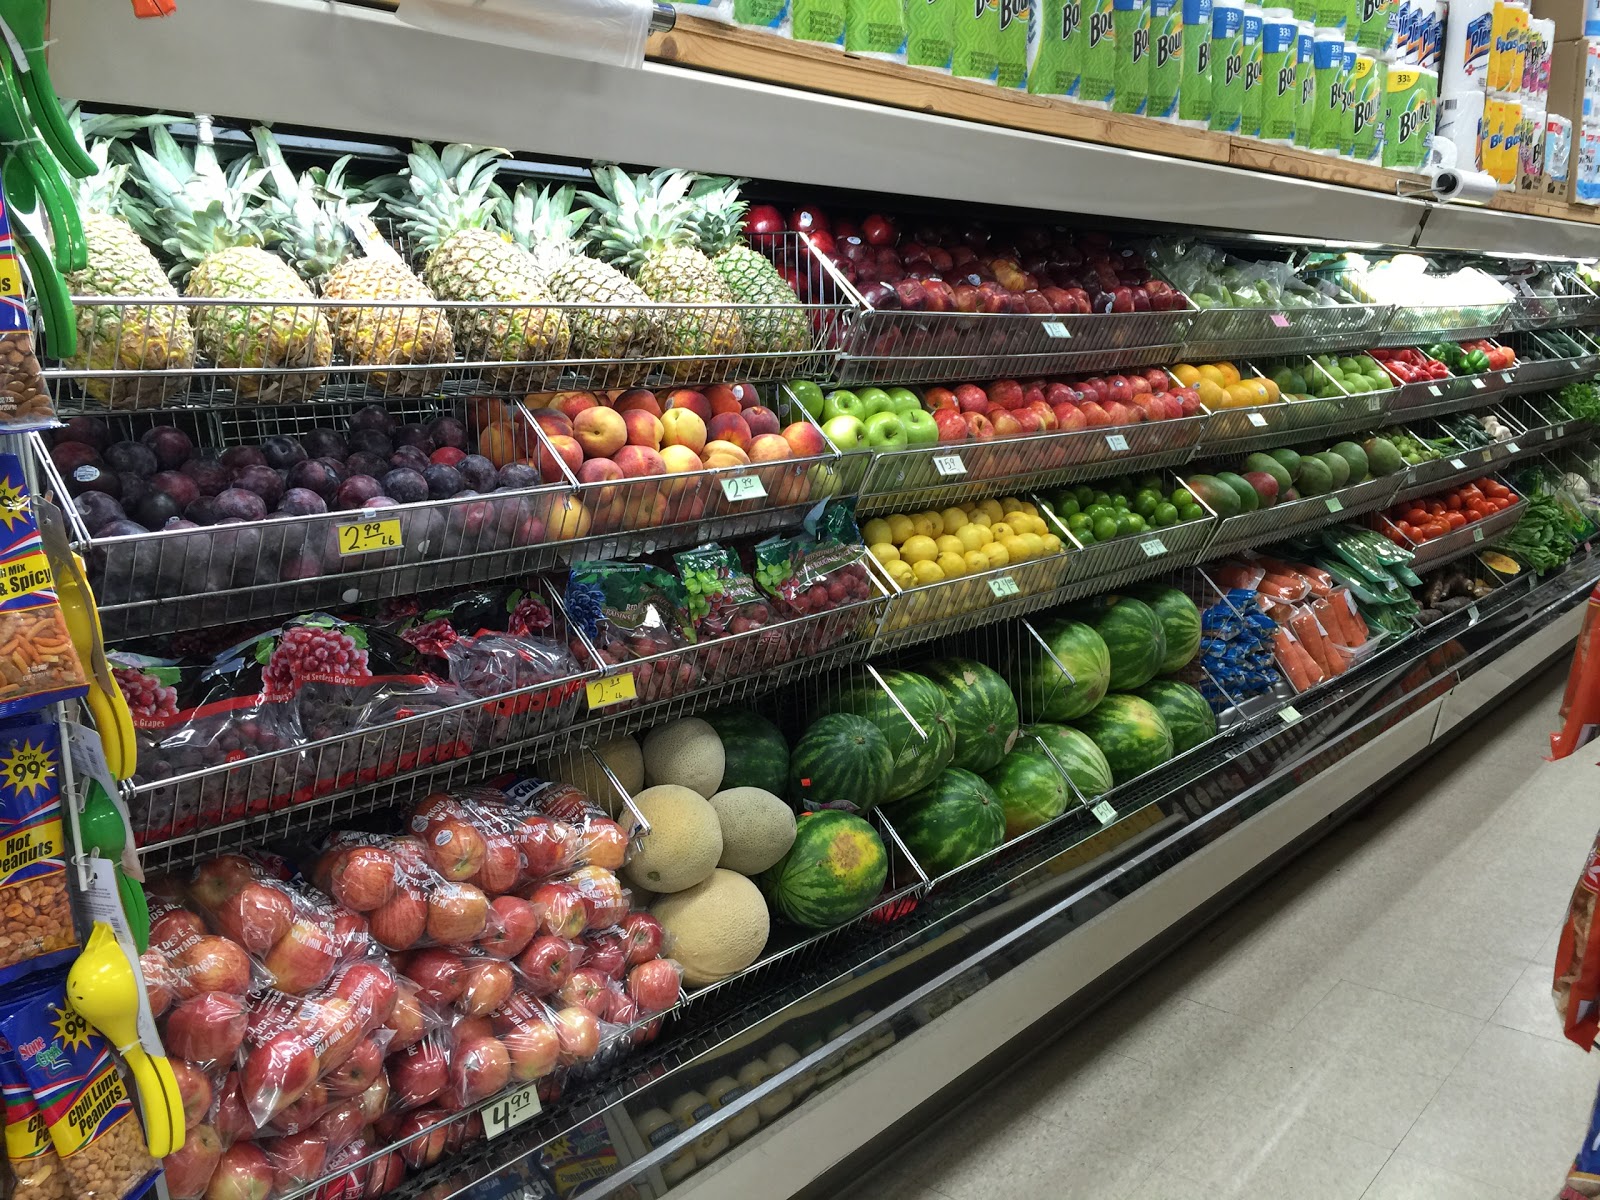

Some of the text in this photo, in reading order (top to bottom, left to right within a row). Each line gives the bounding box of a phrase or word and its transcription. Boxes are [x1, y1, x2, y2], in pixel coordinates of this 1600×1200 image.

[345, 523, 384, 551] 2.99
[8, 563, 26, 576] Mix
[11, 567, 51, 592] Spicy
[335, 675, 356, 686] Grapes
[139, 716, 165, 729] Grapes
[18, 752, 38, 762] Only
[0, 841, 53, 873] eanuts
[6, 833, 31, 856] Hot
[18, 1036, 47, 1061] Stone
[35, 1040, 64, 1068] Creek
[68, 1069, 120, 1128] Chili Lime
[493, 1091, 531, 1131] 4.99
[79, 1085, 123, 1138] Peanuts
